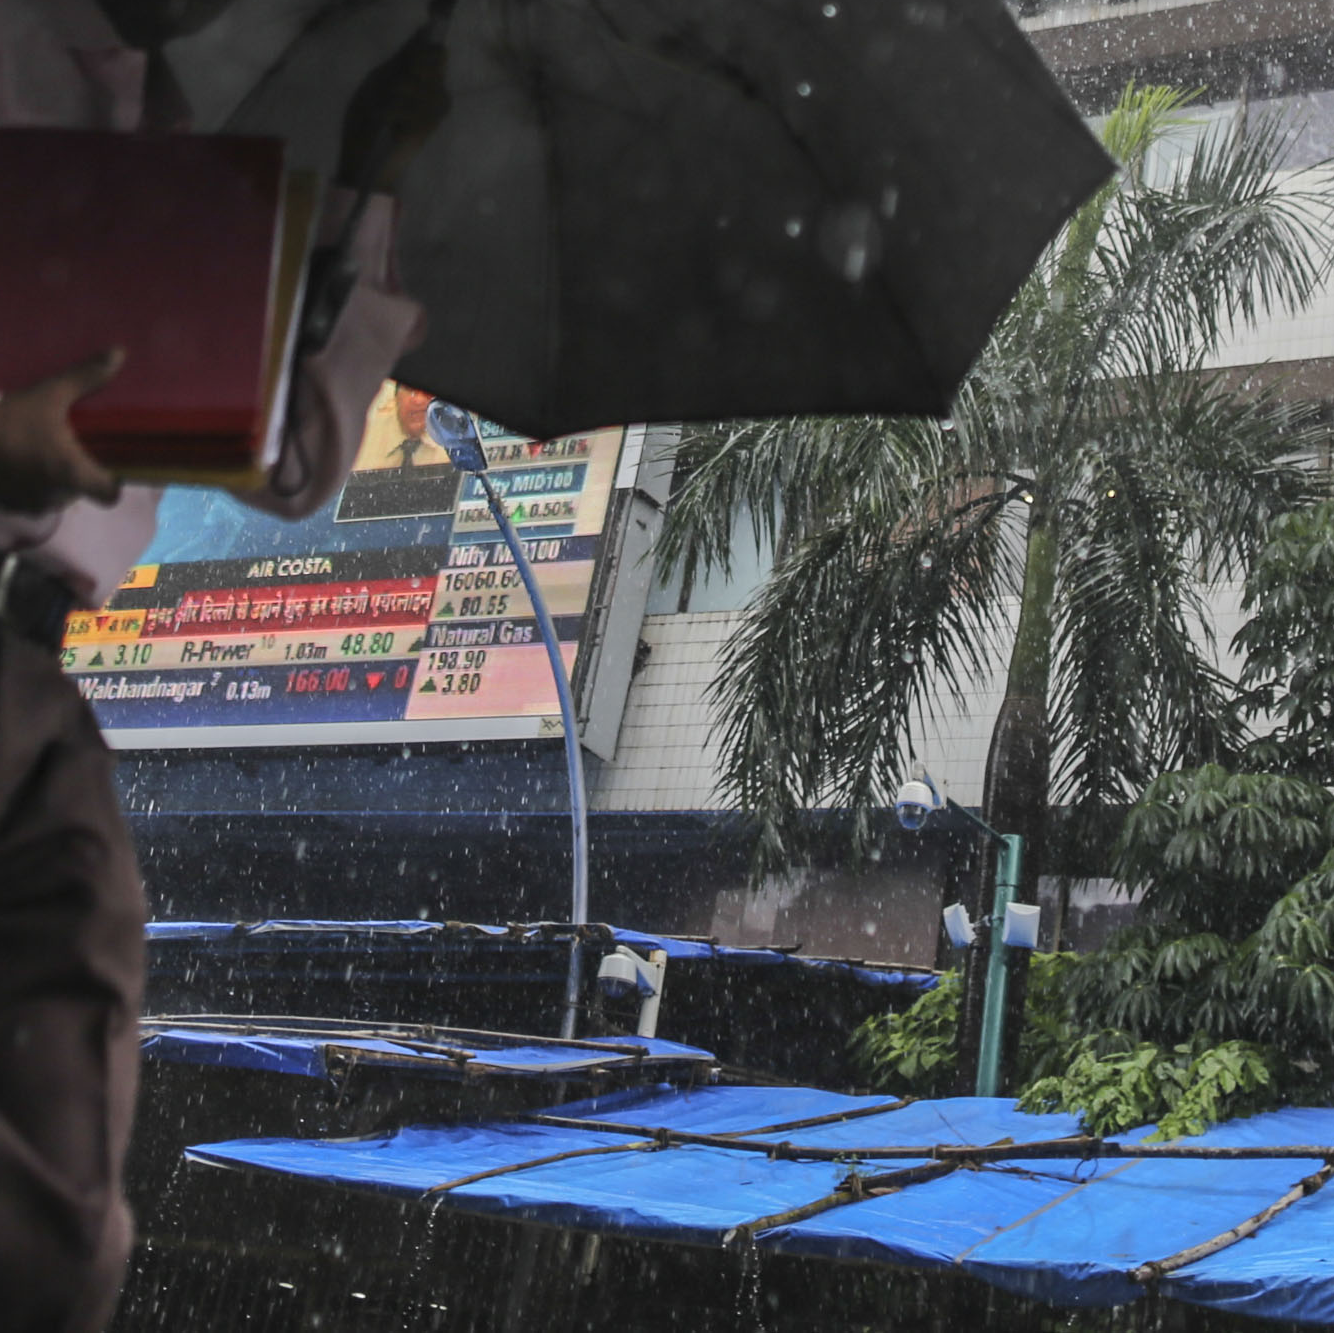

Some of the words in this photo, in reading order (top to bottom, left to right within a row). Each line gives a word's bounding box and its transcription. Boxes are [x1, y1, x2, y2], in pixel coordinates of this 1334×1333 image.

[247, 560, 274, 578] AIR
[277, 558, 332, 577] COSTA
[448, 544, 490, 568] Nifty
[431, 622, 496, 647] Natural
[499, 621, 533, 643] Gas
[114, 643, 153, 665] 3.10
[181, 640, 256, 663] R-Power
[341, 632, 395, 656] 48.80
[78, 675, 205, 703] Walchandnagar
[226, 679, 272, 701] 0.13m
[441, 672, 482, 694] 3.80
